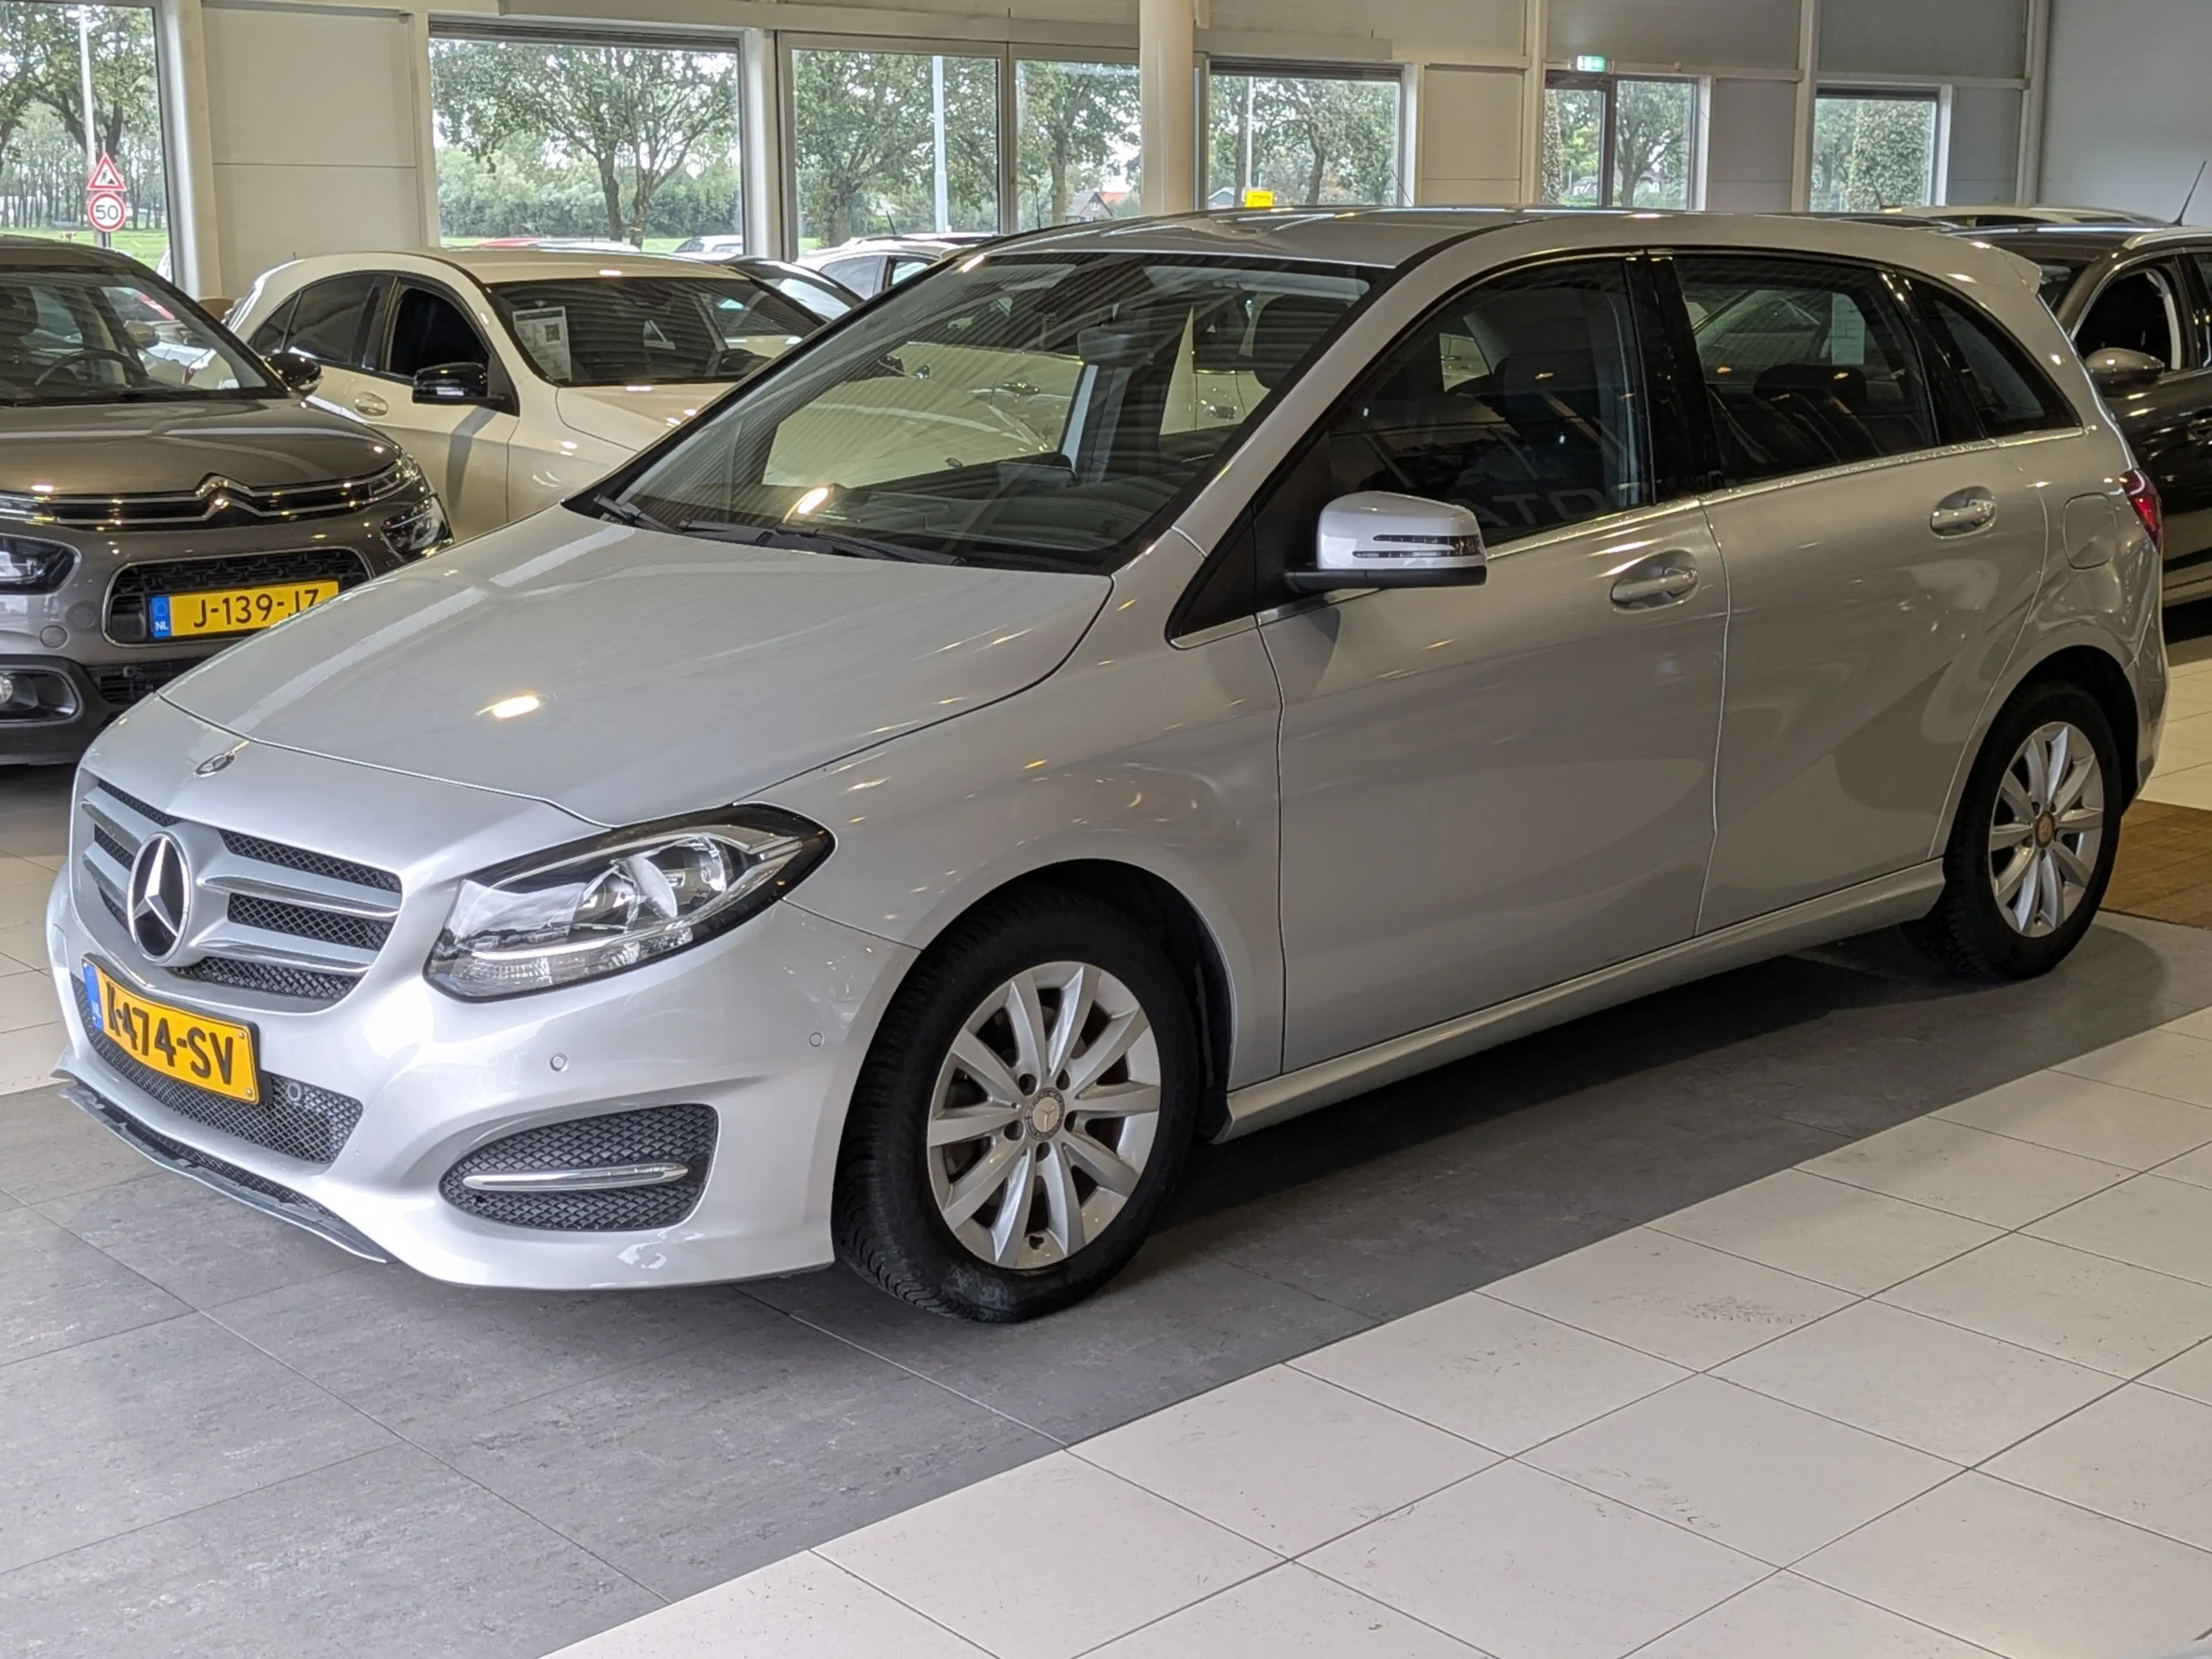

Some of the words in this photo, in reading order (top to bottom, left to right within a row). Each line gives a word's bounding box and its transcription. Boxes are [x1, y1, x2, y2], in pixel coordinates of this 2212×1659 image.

[96, 204, 119, 220] 50
[156, 620, 169, 631] NL
[107, 981, 234, 1085] K-474-SV
